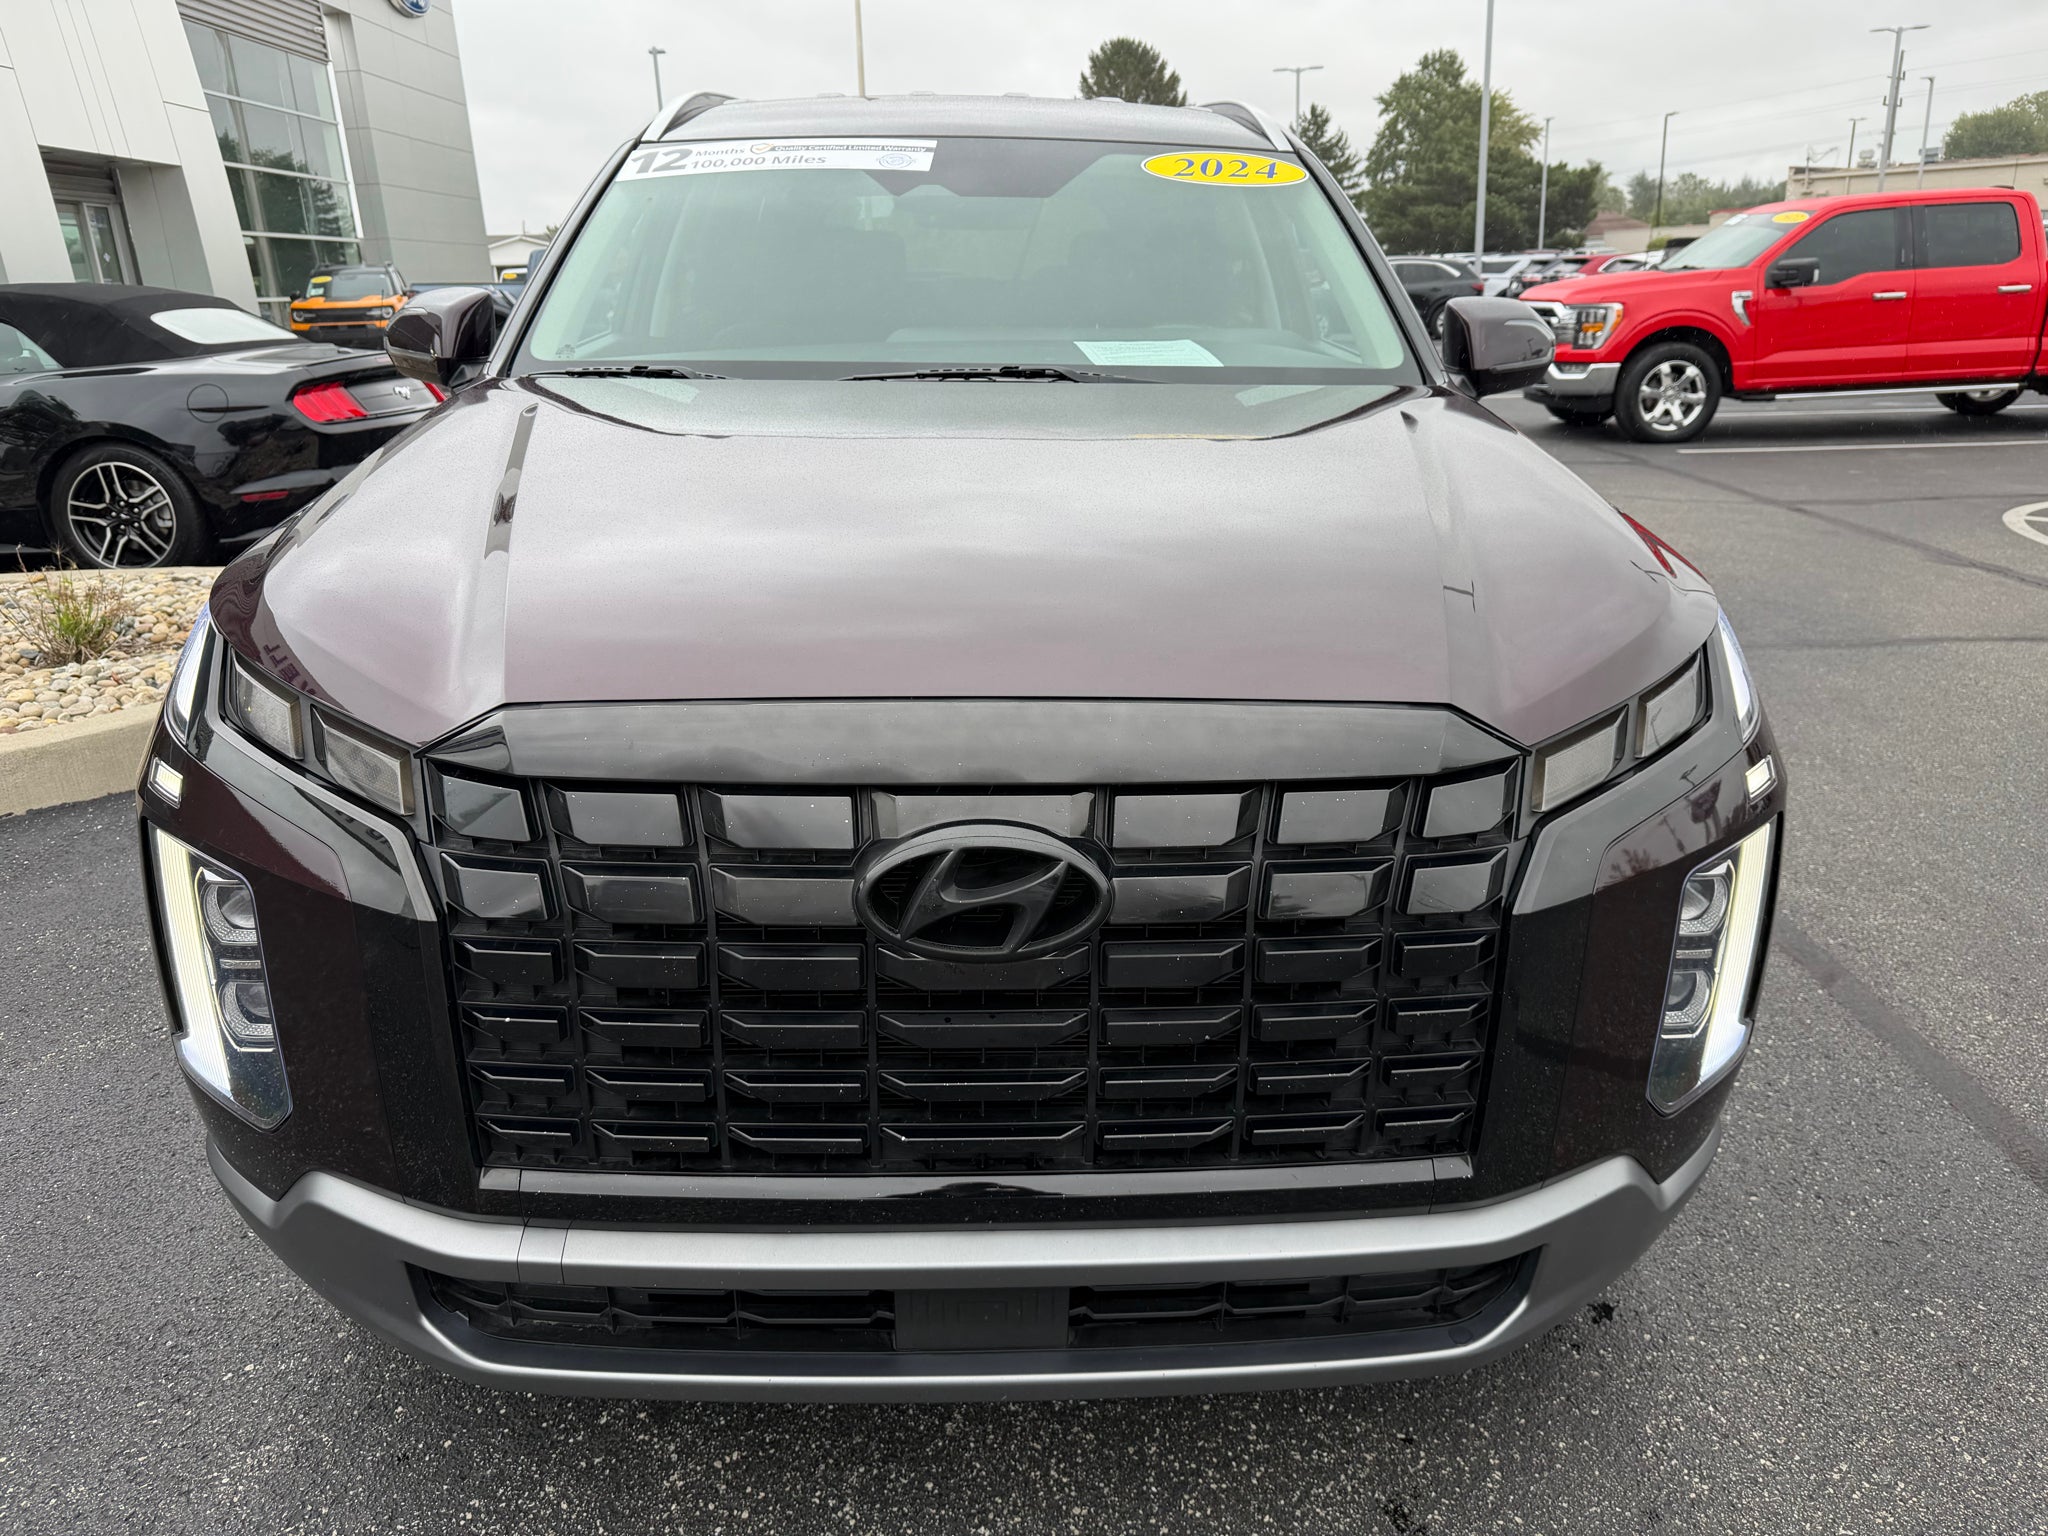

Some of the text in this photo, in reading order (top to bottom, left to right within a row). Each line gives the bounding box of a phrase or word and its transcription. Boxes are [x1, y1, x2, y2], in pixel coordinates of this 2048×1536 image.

[695, 148, 745, 157] Months
[631, 149, 692, 174] 12
[691, 155, 828, 169] 100,000 Miles
[1173, 158, 1278, 179] 2024
